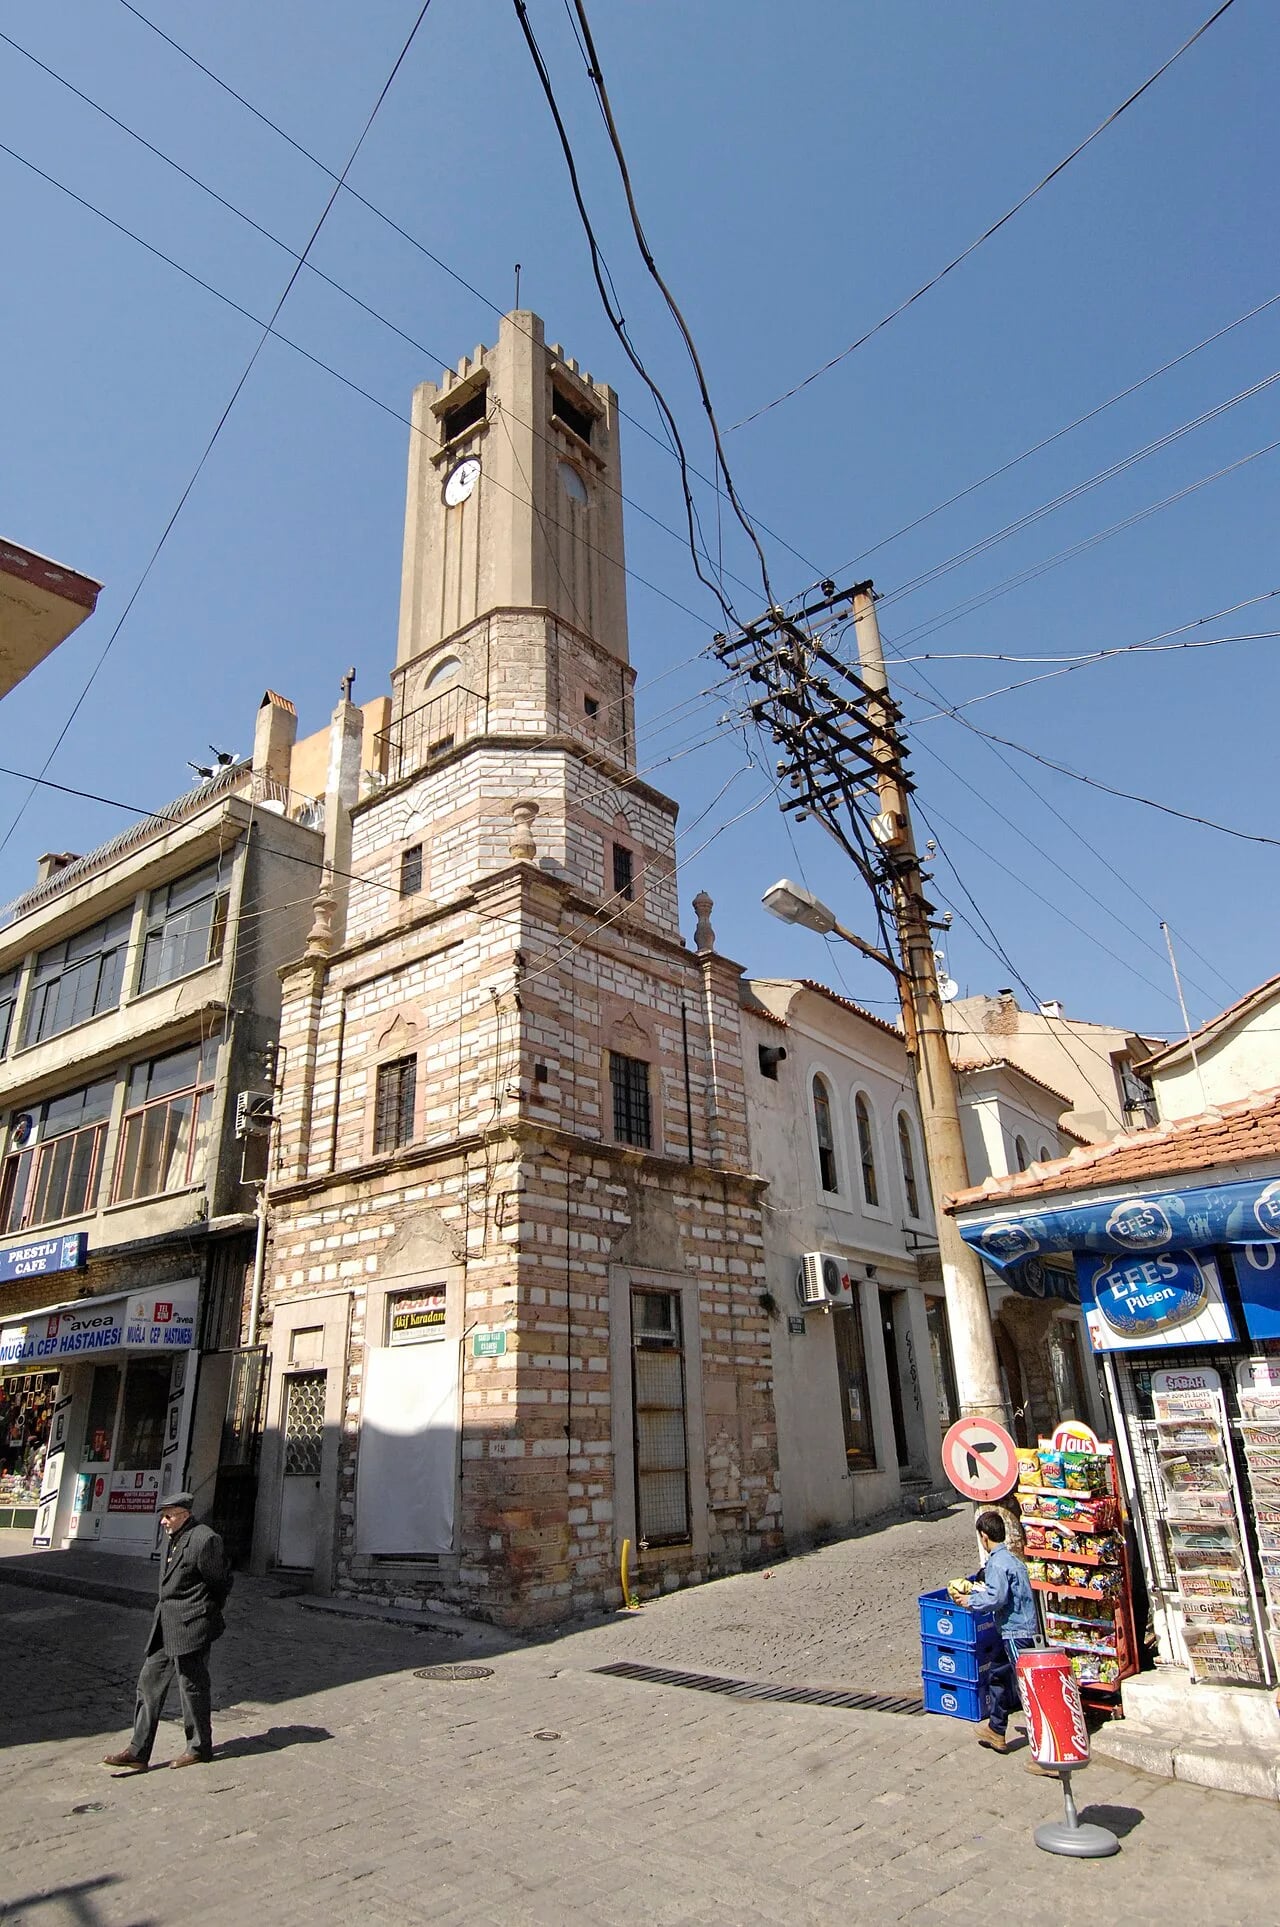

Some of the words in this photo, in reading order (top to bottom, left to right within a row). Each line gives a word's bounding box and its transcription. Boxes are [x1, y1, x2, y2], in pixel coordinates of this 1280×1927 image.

[1115, 1209, 1155, 1236] EFES
[8, 1242, 57, 1263] PRESTİJ
[15, 1258, 47, 1275] CAFE
[1106, 1253, 1179, 1300] EFES
[1125, 1286, 1176, 1314] Pilsen
[70, 1316, 114, 1331] avea
[394, 1314, 410, 1329] Akif
[0, 1341, 34, 1361] MUĞLA
[37, 1338, 58, 1356] CEP
[60, 1327, 122, 1352] HASTANESİ
[127, 1324, 146, 1343] MUĞLA
[150, 1327, 161, 1344] CEP
[1167, 1377, 1206, 1389] SABAH
